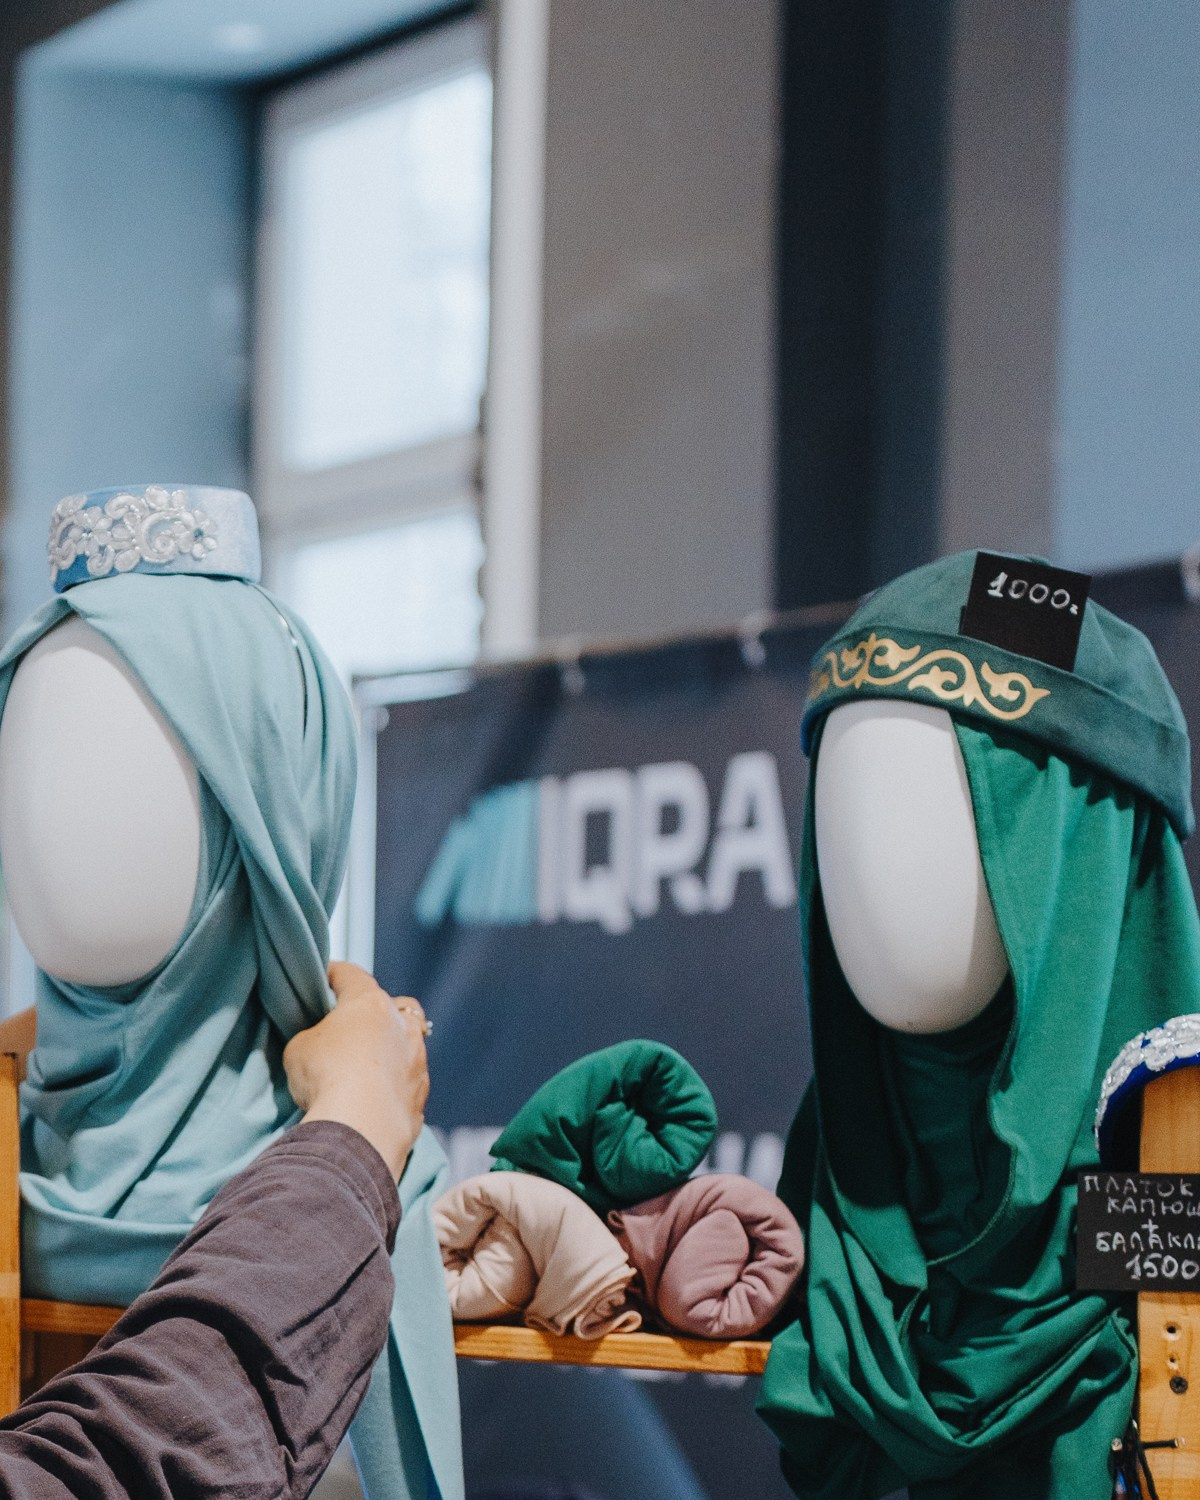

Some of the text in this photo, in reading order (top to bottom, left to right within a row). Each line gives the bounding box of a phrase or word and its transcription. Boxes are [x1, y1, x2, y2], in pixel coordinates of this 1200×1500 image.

[538, 751, 798, 933] IQRA
[1084, 1175, 1194, 1197] ПЛАТОК
[1125, 1252, 1200, 1280] 1500
